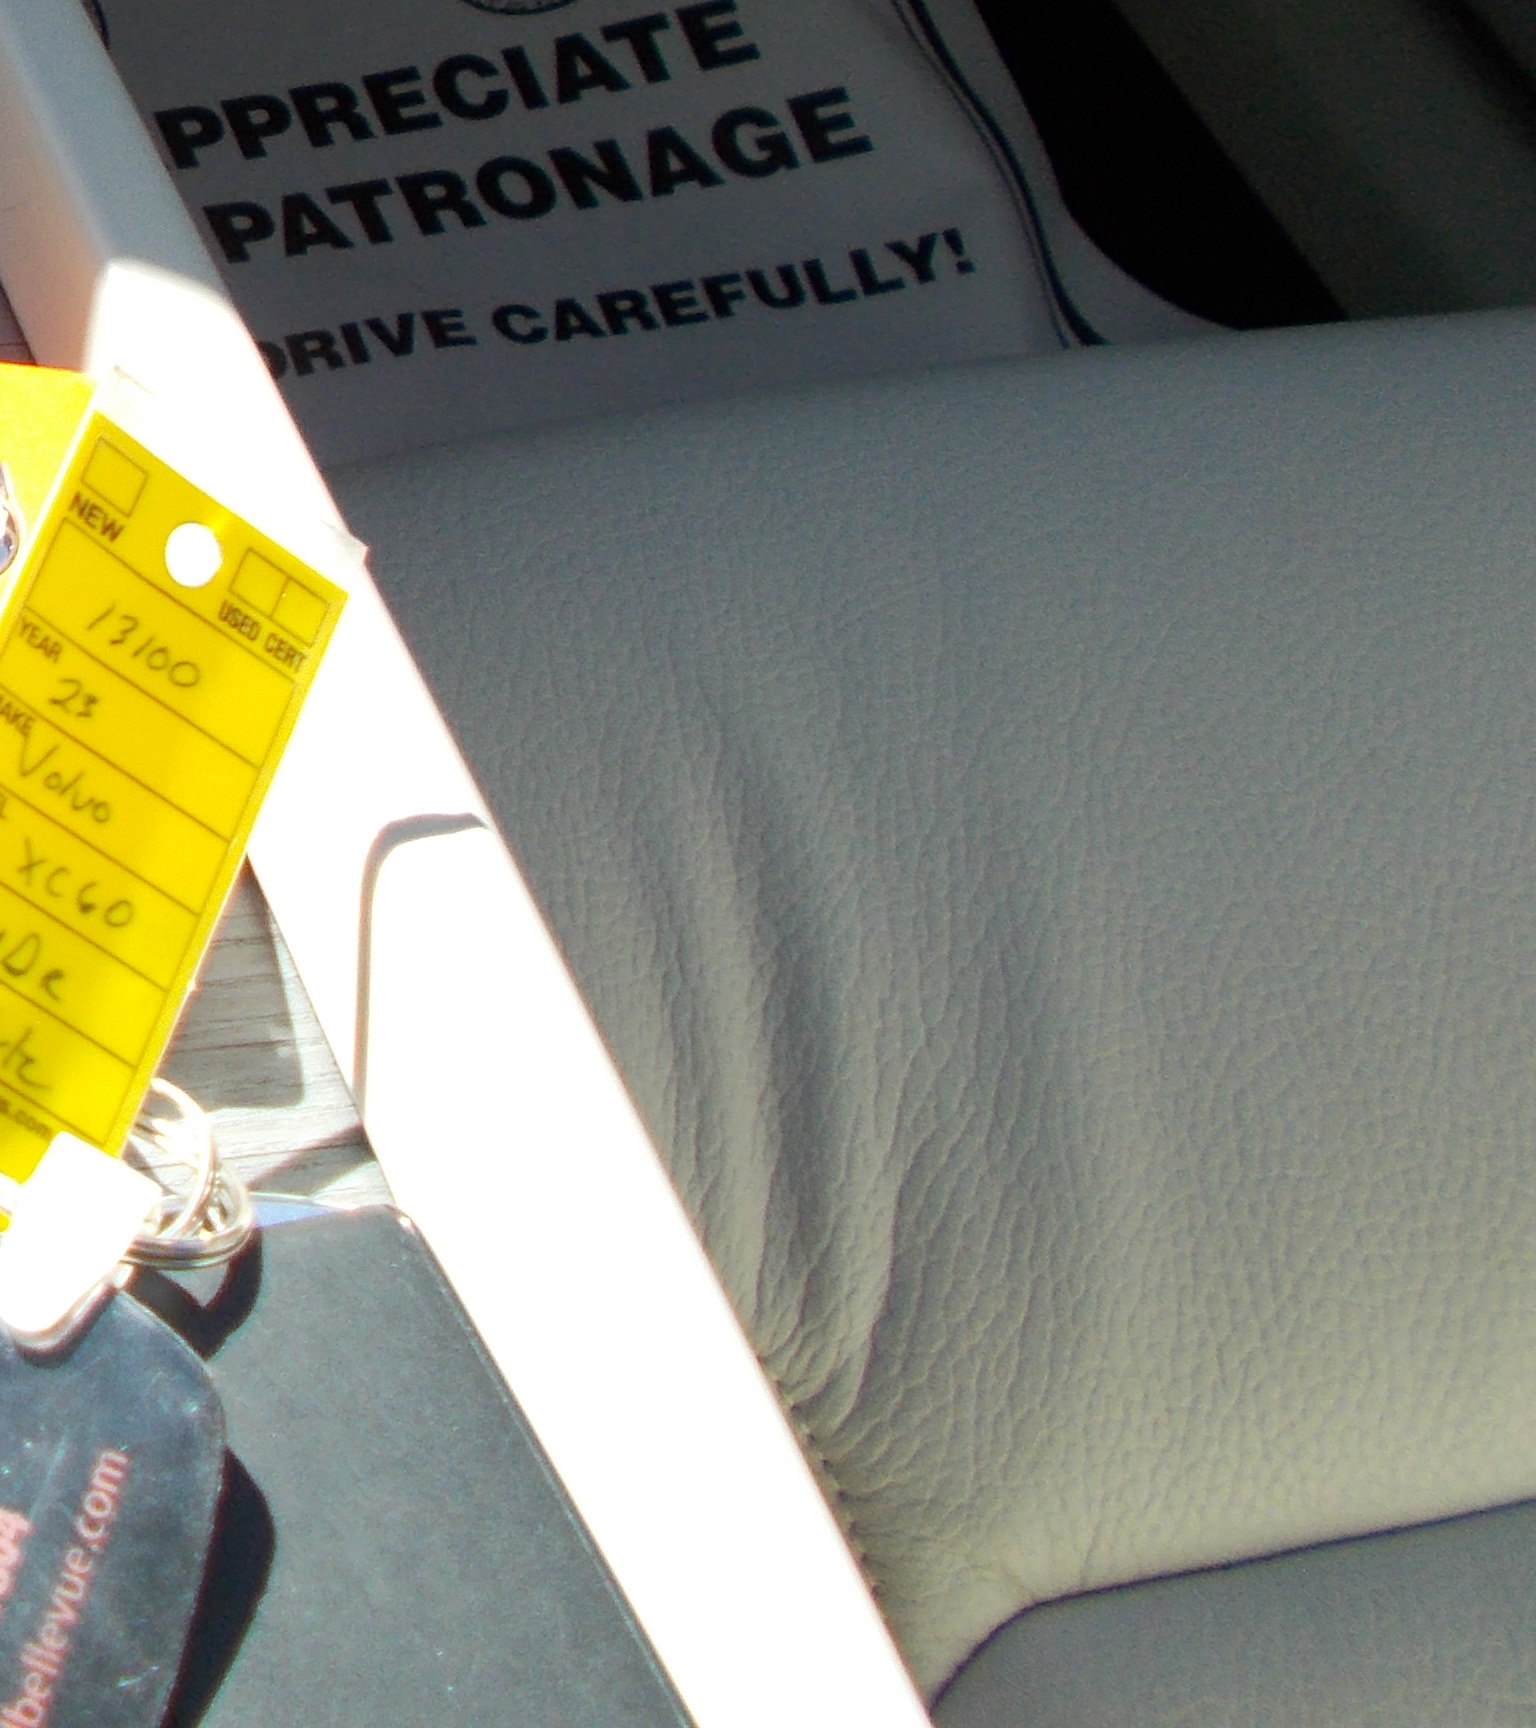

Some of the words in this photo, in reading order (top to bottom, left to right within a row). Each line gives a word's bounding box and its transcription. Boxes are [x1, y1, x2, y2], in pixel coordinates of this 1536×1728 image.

[202, 86, 874, 264] PATRONAGE
[491, 227, 976, 344] CAREFULLY!
[68, 490, 126, 543] NEW
[17, 616, 65, 664] YEAR
[87, 603, 202, 688] 13100
[218, 600, 261, 643] USED
[261, 629, 307, 671] CERT
[47, 677, 101, 719] 23
[19, 734, 111, 824] Volvo
[16, 836, 134, 928] XC60
